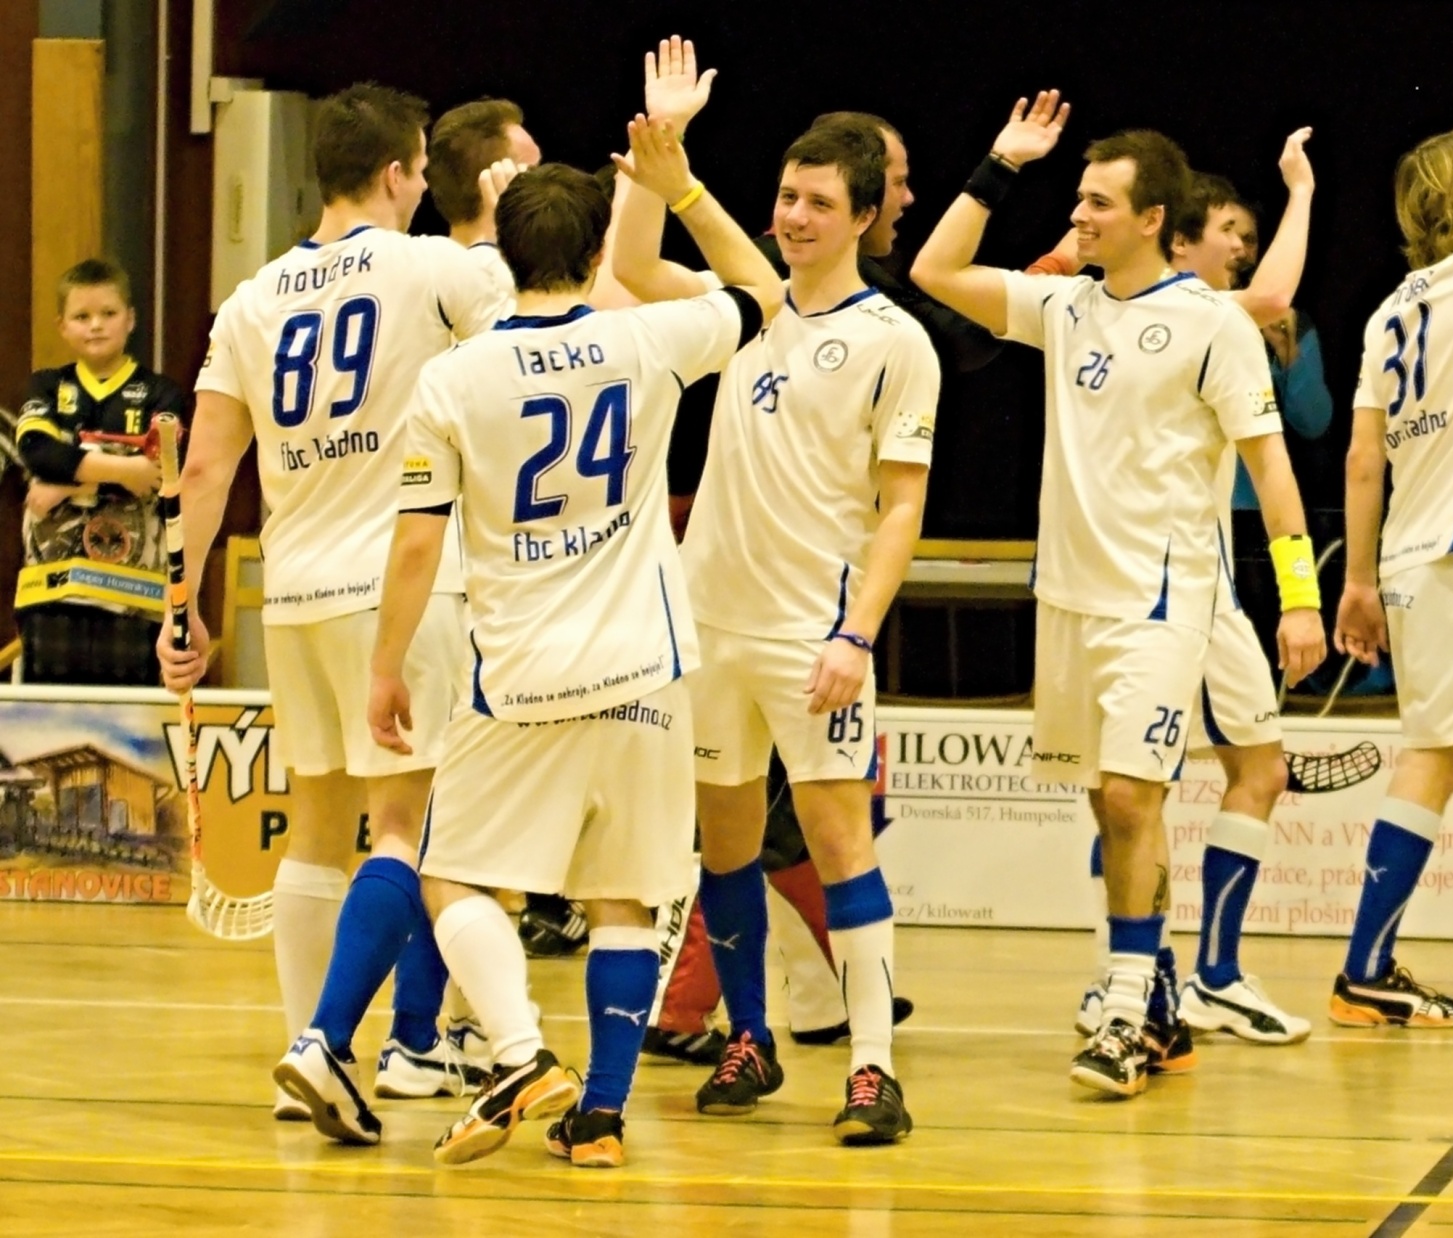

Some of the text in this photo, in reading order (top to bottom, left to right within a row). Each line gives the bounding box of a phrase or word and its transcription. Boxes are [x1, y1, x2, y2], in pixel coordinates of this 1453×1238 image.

[273, 293, 380, 427] 89
[512, 342, 604, 376] lacko
[1076, 351, 1114, 390] 26
[1383, 300, 1433, 418] 31
[511, 378, 637, 524] 24
[514, 532, 553, 562] fbc
[516, 692, 543, 704] Kladno
[546, 694, 554, 702] se
[592, 683, 601, 692] za
[602, 673, 629, 688] Kladno
[631, 671, 639, 680] se
[827, 702, 863, 743] 85
[1144, 706, 1183, 748] 26
[900, 804, 1077, 827] Dvorská 517, Humpolec
[1274, 821, 1315, 846] NN
[1322, 829, 1334, 846] a
[0, 869, 171, 900] STANOVICE
[1321, 862, 1365, 893] prác
[1288, 898, 1354, 932] plošin
